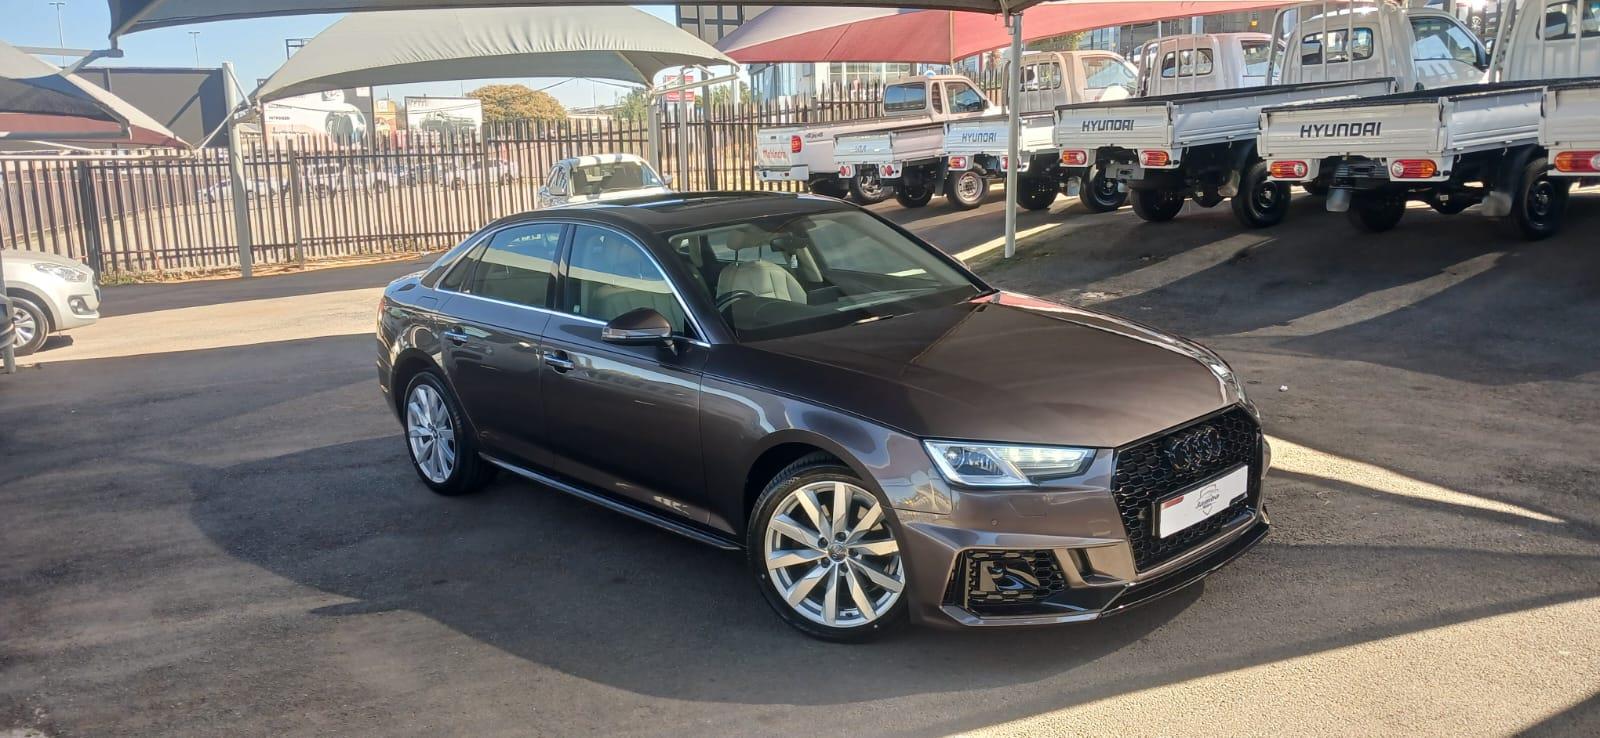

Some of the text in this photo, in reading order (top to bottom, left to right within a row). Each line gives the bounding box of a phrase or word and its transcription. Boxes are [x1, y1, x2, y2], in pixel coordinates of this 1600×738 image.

[1081, 119, 1135, 132] HYUNDAI
[1300, 121, 1382, 138] HYUNDAI
[961, 132, 997, 143] HYUNDAI
